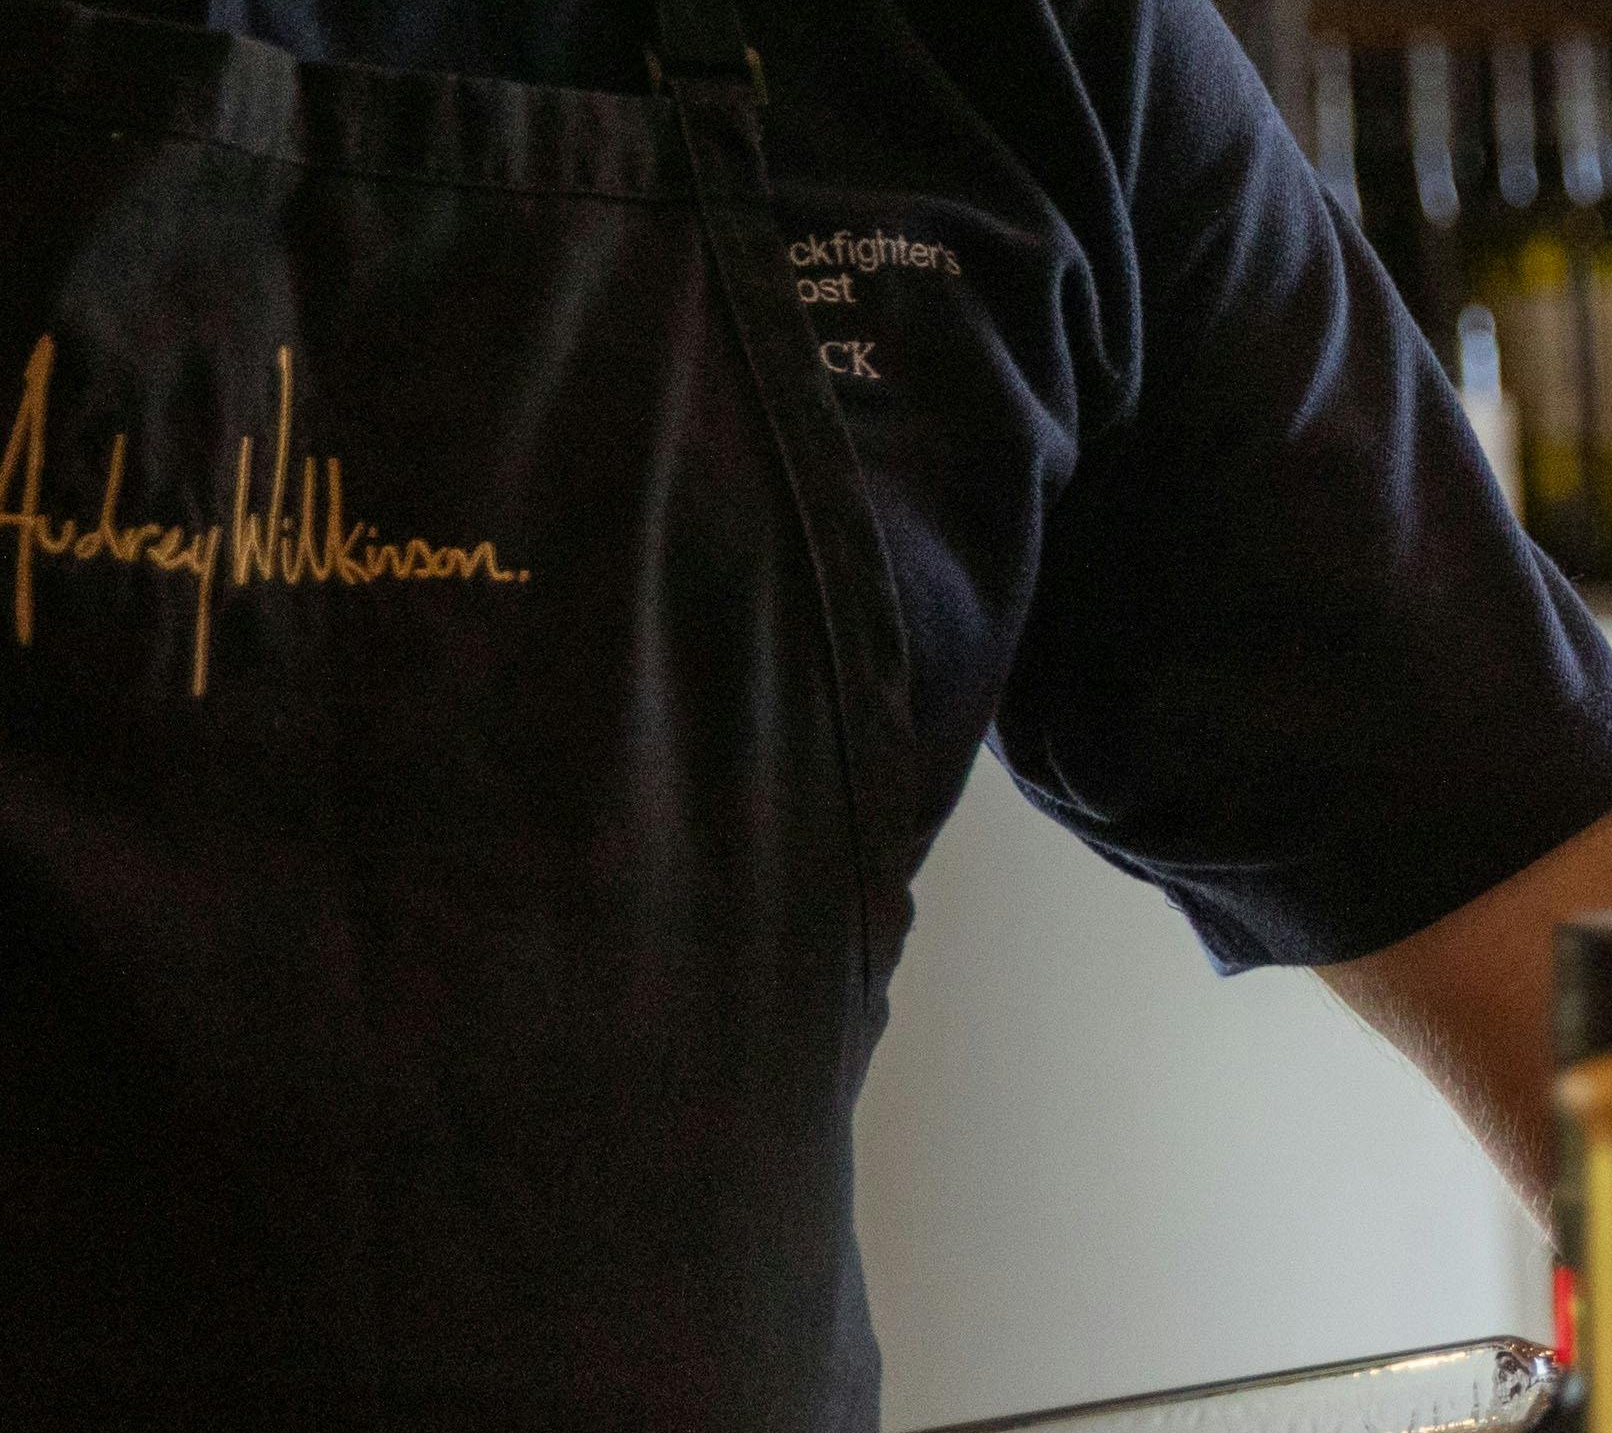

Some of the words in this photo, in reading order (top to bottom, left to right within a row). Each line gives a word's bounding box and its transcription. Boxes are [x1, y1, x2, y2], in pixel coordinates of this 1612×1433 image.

[789, 228, 961, 275] ckfighter's
[797, 271, 858, 303] ost
[820, 340, 881, 379] CK
[0, 333, 222, 695] Audrey
